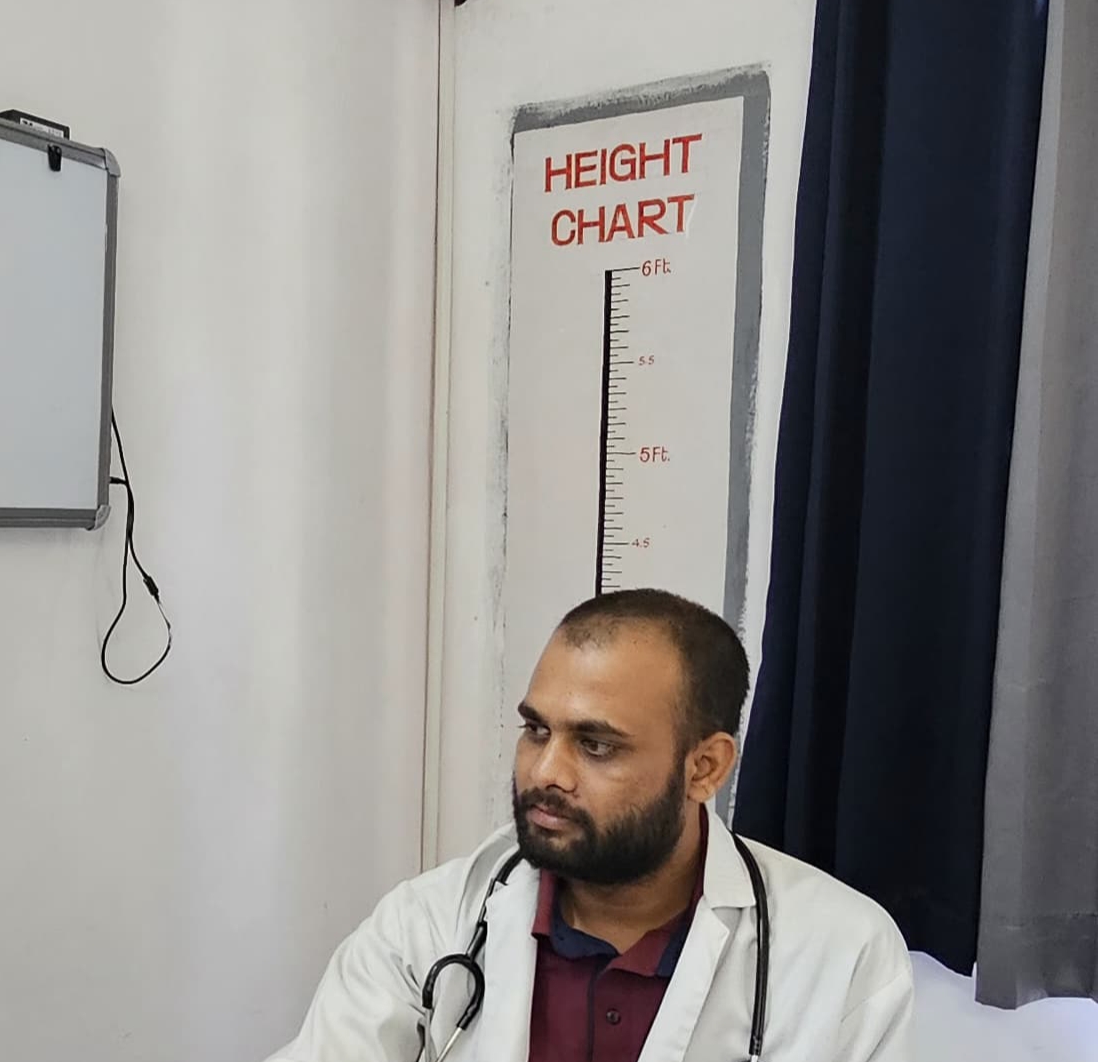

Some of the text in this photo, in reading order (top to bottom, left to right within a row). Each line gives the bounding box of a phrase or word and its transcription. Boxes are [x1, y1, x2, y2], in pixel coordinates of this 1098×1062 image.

[544, 133, 703, 193] HEIGHT
[551, 194, 696, 247] CHART
[631, 537, 650, 549] 4.5
